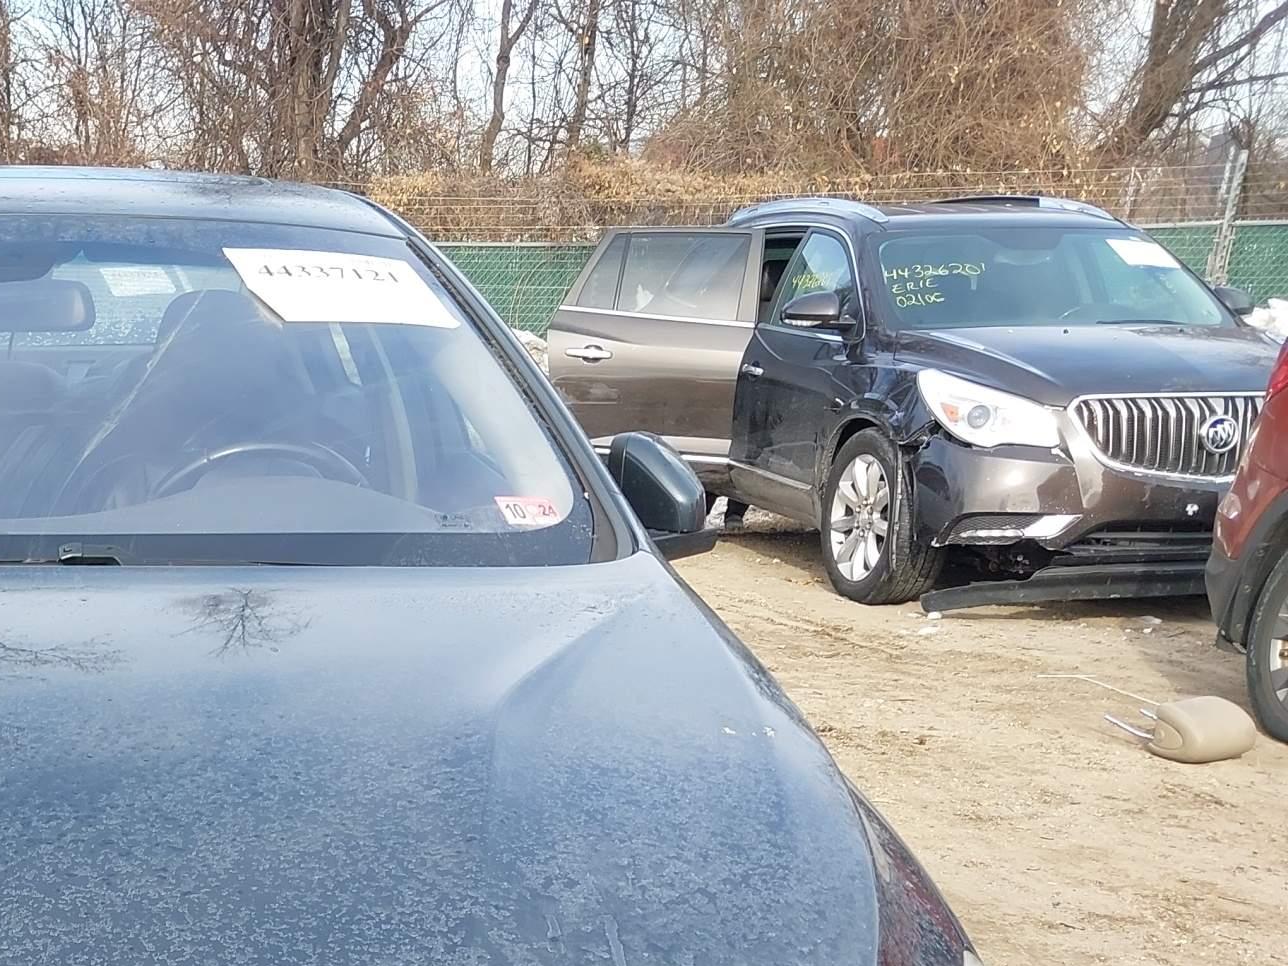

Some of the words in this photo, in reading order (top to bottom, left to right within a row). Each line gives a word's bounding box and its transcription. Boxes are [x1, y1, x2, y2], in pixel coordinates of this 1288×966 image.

[258, 264, 399, 283] 44337121
[892, 278, 939, 294] ERIE
[505, 503, 527, 519] 10
